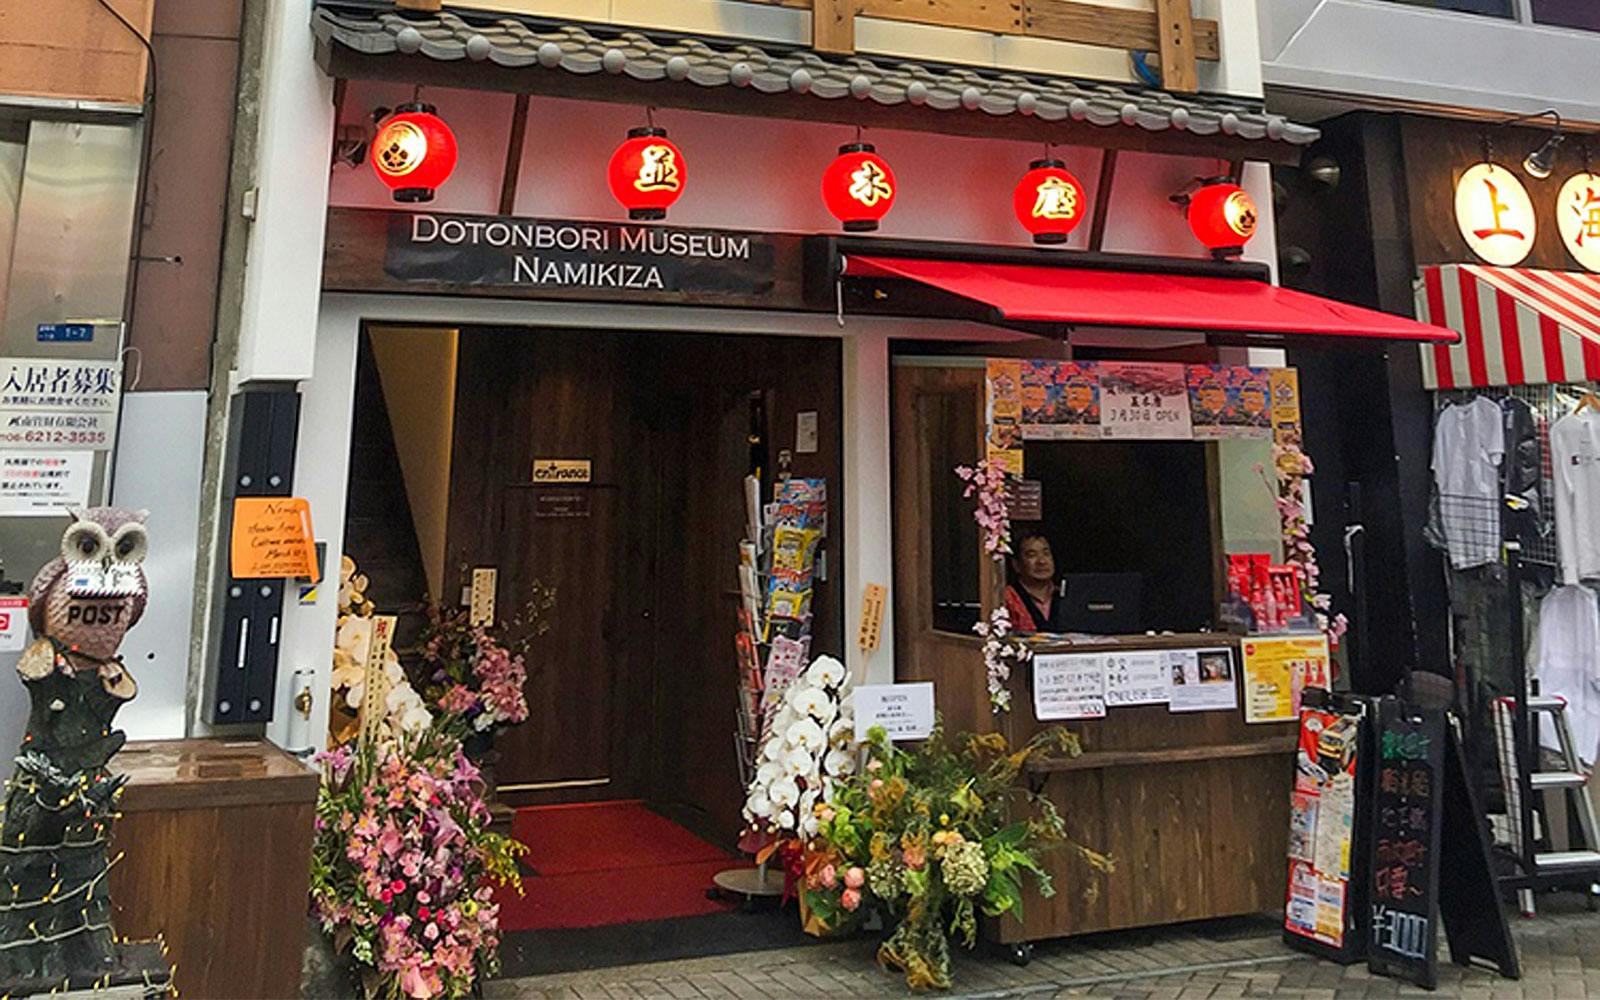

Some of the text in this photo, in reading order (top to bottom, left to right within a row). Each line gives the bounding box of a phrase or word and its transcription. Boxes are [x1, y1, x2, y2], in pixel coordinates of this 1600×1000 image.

[1473, 179, 1525, 241] 上
[411, 213, 750, 259] DOTONBORI MUSEUM
[513, 255, 664, 290] NAMIKIZA
[3, 366, 115, 394] 入居者募集
[67, 605, 125, 625] POST
